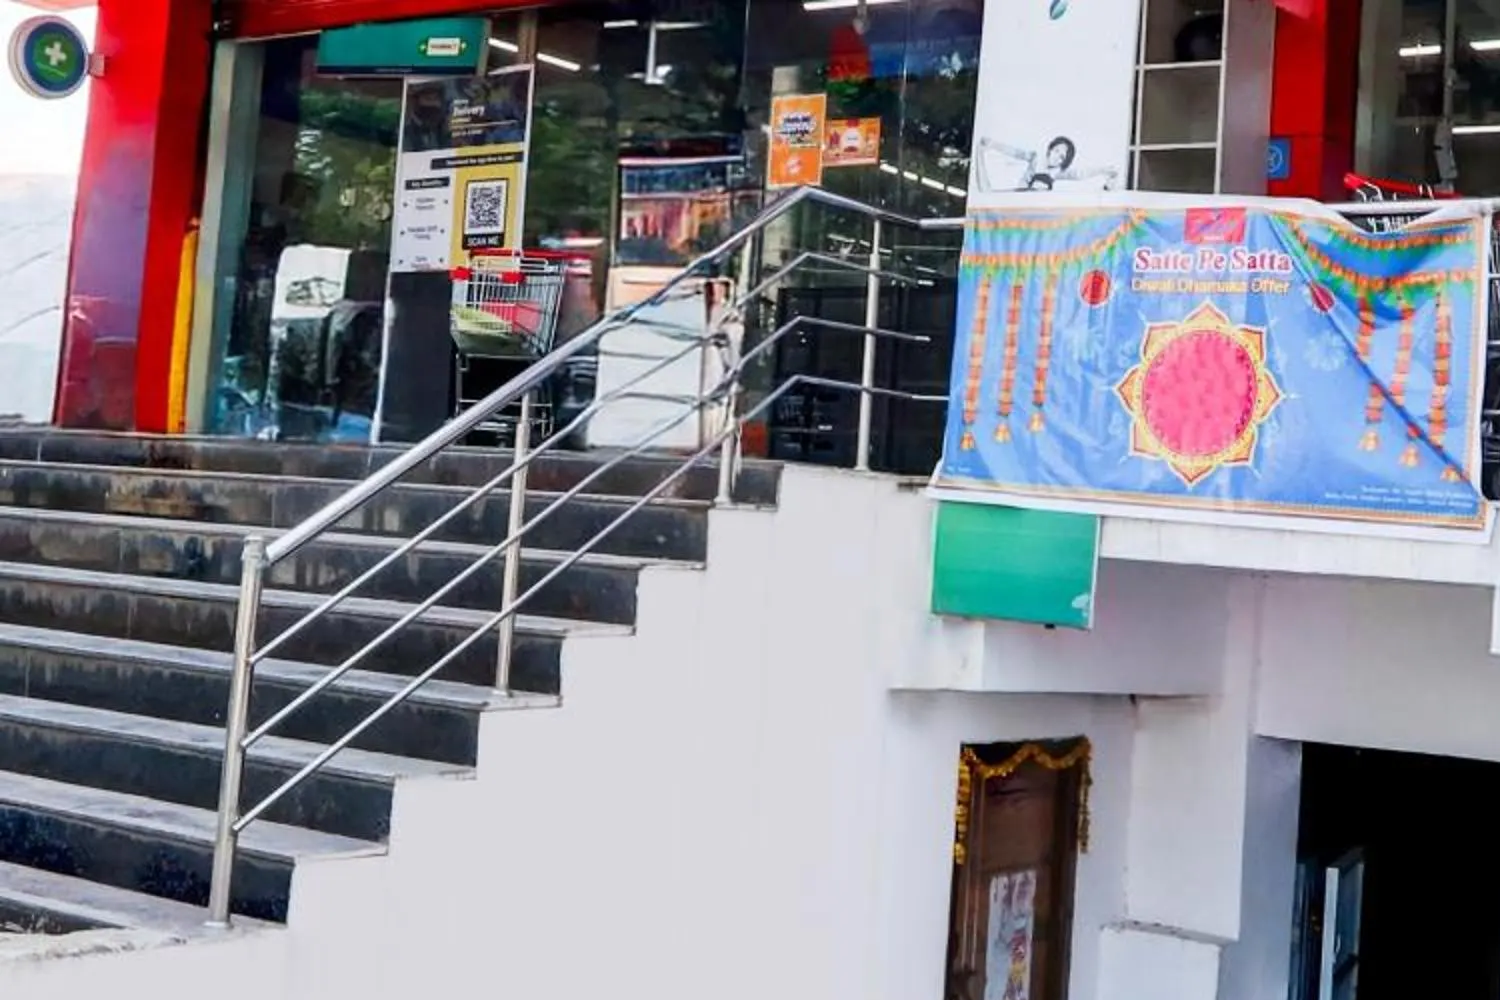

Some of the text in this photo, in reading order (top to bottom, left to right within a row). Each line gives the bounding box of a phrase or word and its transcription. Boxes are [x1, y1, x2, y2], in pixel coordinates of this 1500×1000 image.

[1135, 247, 1291, 271] Satte Pe Satta
[1251, 278, 1290, 293] Offer
